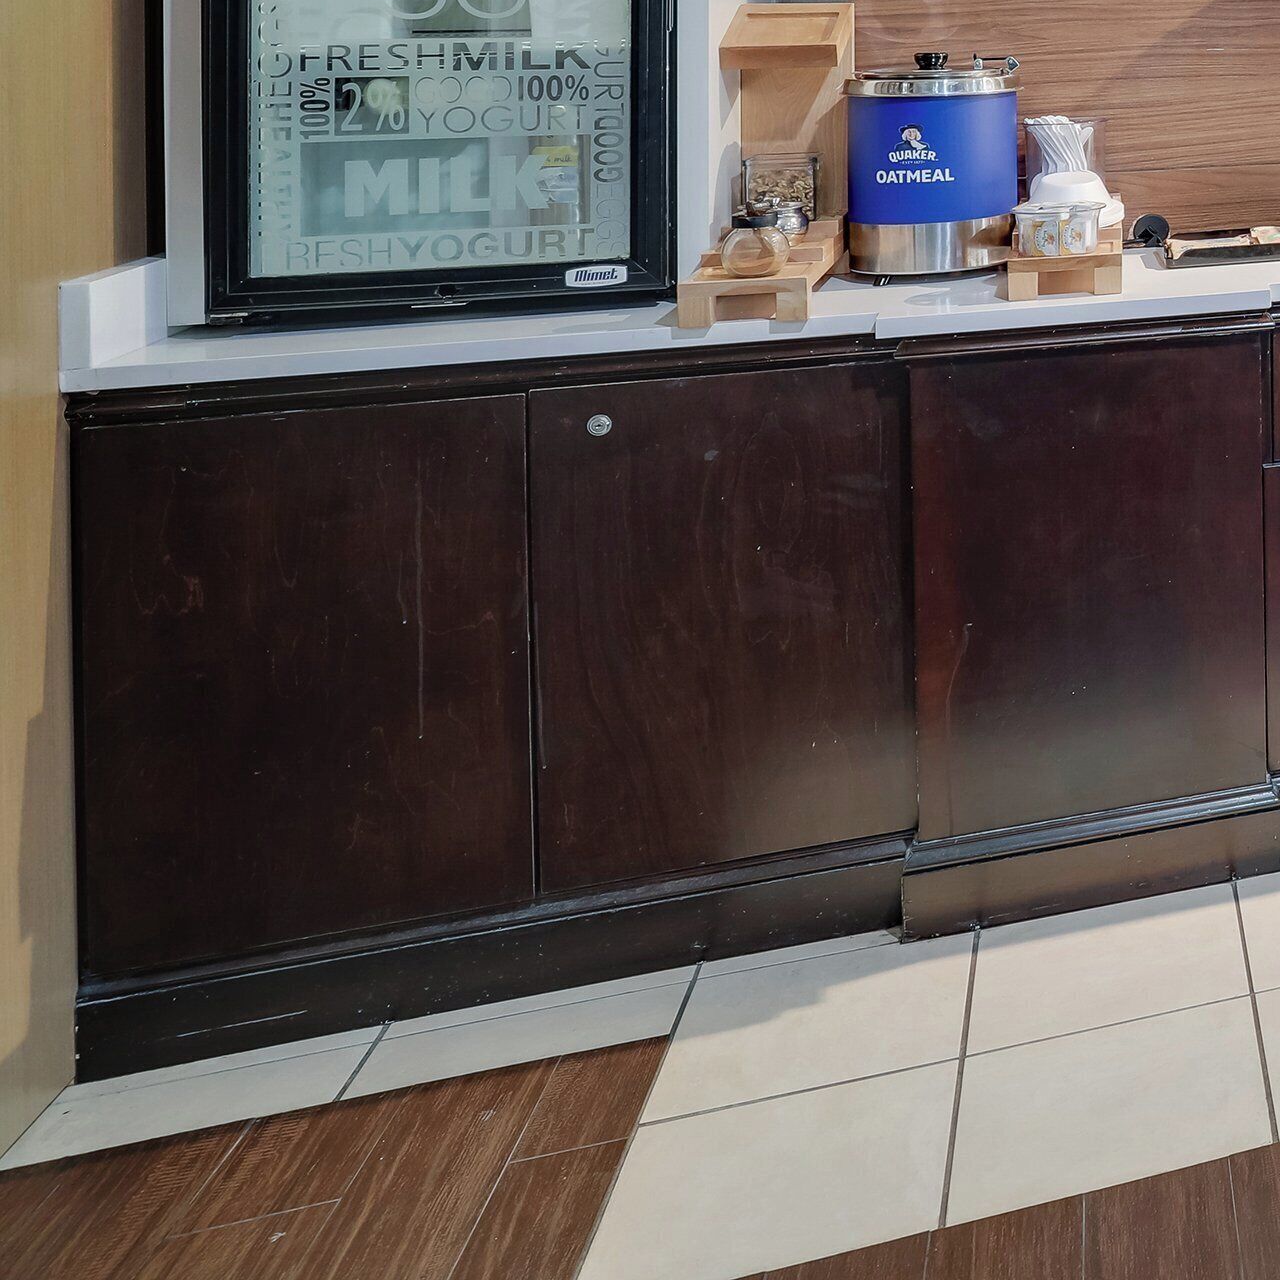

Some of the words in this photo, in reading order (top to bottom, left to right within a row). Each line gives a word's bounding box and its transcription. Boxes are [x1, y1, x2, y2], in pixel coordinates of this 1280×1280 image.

[300, 44, 444, 71] FRESH
[452, 40, 591, 71] MILK
[518, 75, 589, 102] 100%
[300, 78, 330, 140] 100%
[341, 82, 406, 132] 2%
[417, 103, 586, 136] YOGURT
[888, 150, 937, 163] QUAKER
[344, 154, 550, 218] MILK
[876, 167, 955, 184] OATMEAL
[397, 228, 594, 263] YOGURT
